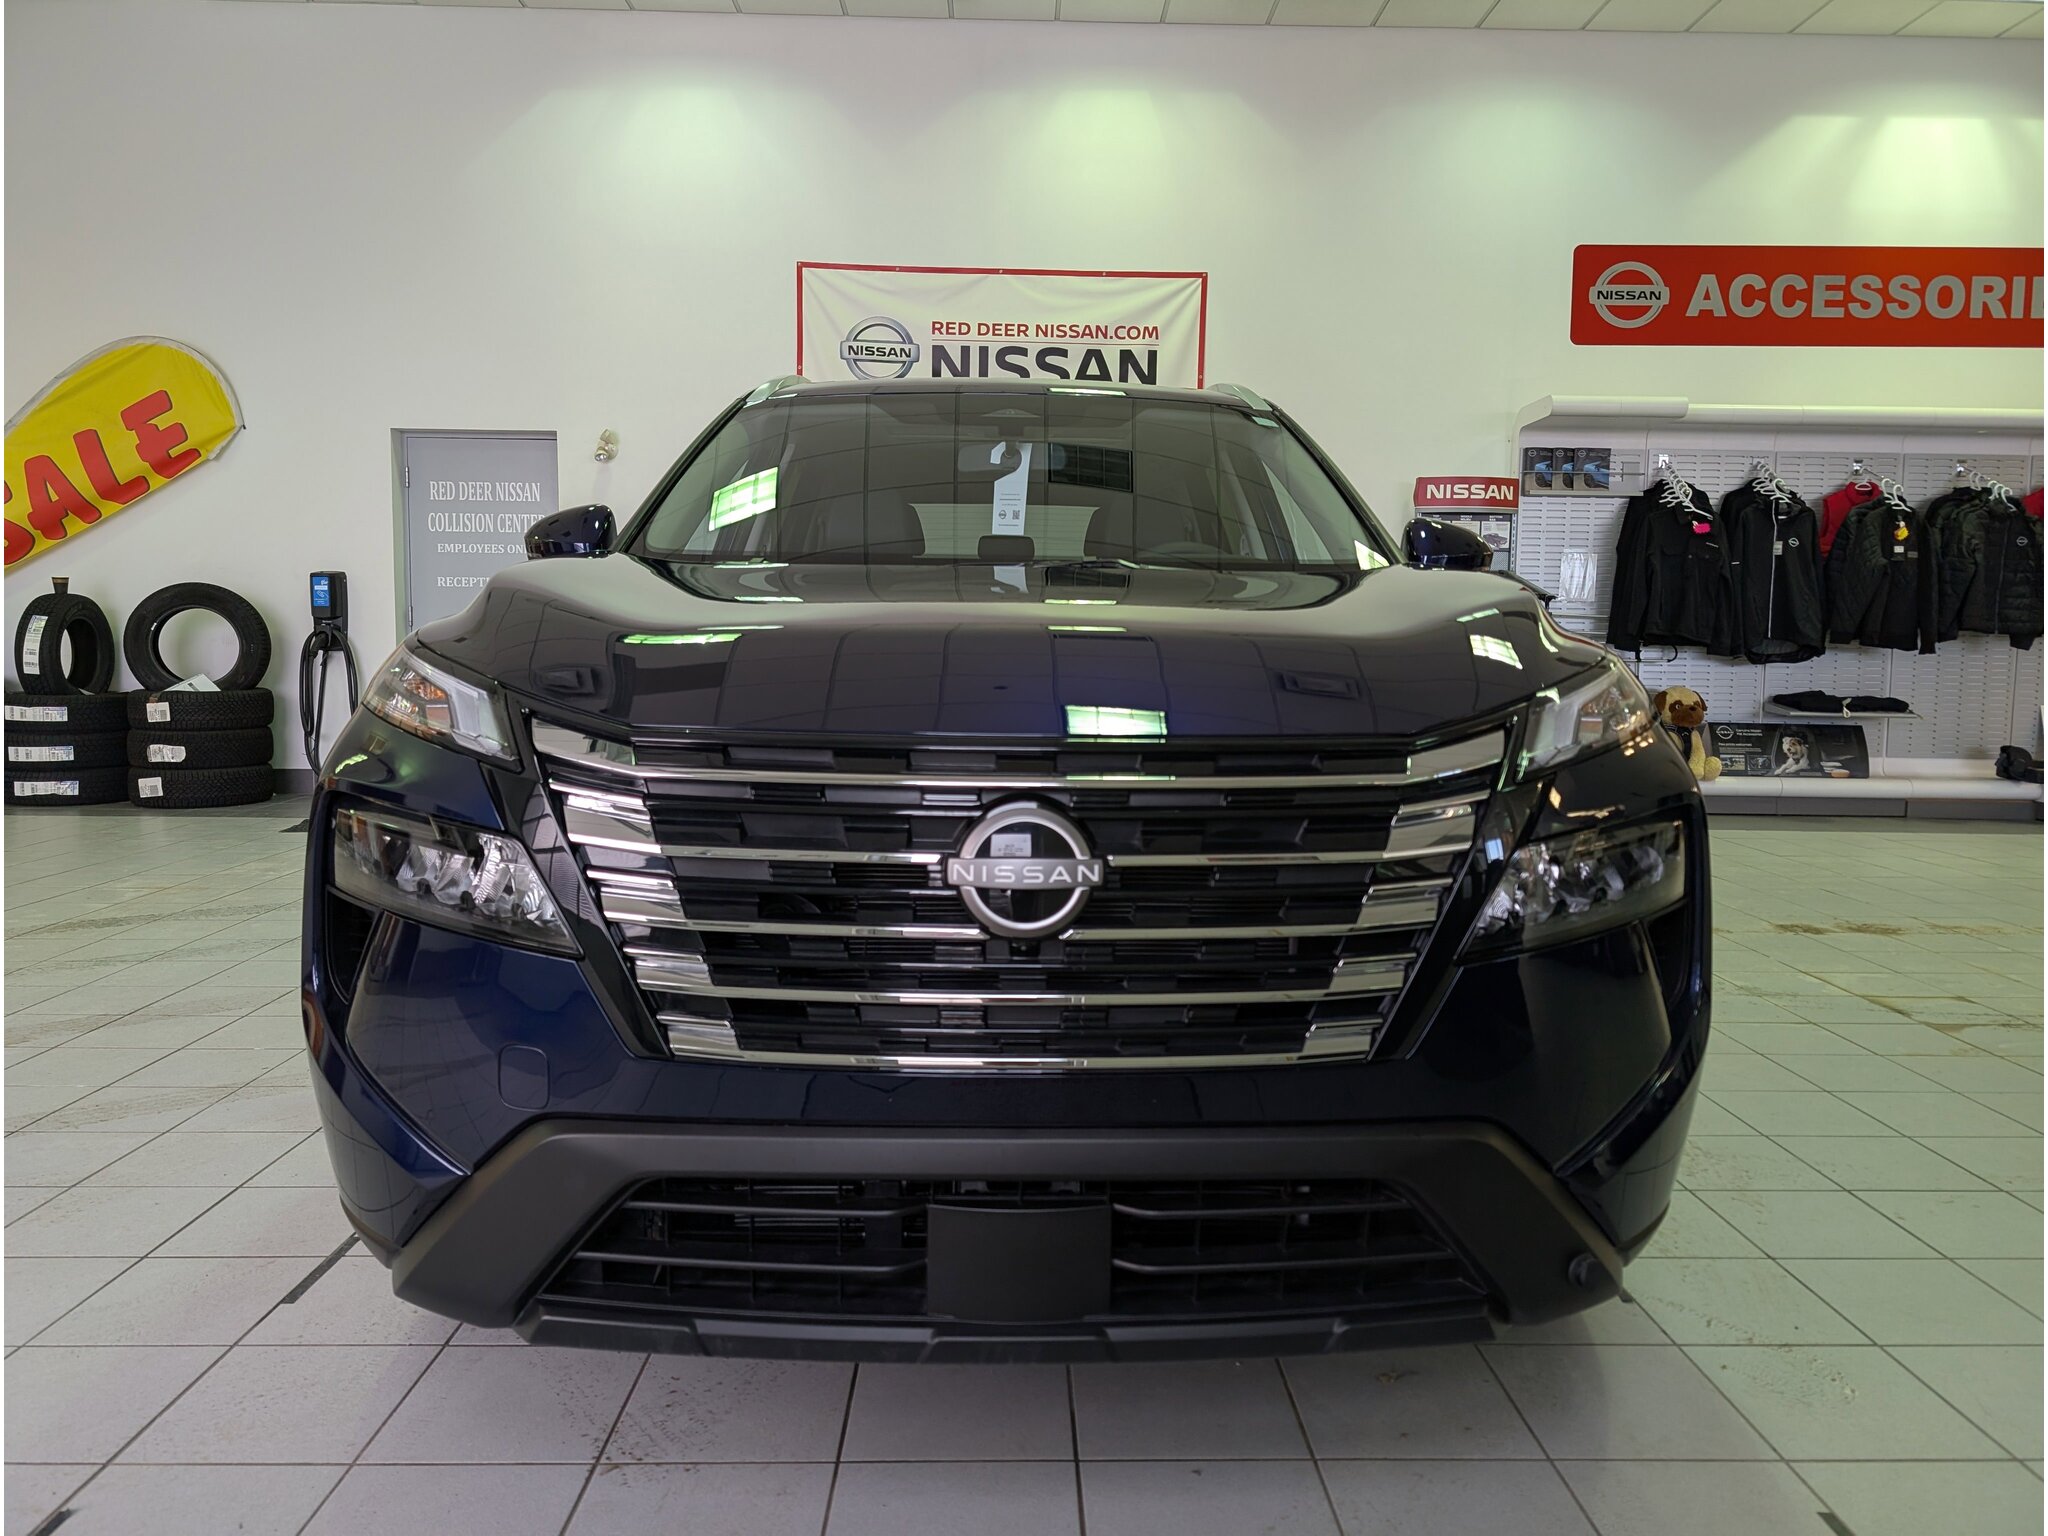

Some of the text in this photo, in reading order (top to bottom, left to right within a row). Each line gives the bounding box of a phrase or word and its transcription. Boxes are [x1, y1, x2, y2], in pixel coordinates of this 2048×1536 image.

[1597, 290, 1661, 301] NISSAN
[931, 320, 1160, 340] RED DEER NISSAN.COM
[848, 344, 912, 359] NISSAN
[931, 345, 1158, 386] NISSAN
[429, 481, 541, 502] RED DEER NISSAN
[1426, 484, 1514, 500] NISSAN
[427, 512, 494, 532] COLLISION
[437, 543, 527, 554] EMPLOYEES ON
[953, 864, 1099, 883] NISSAN
